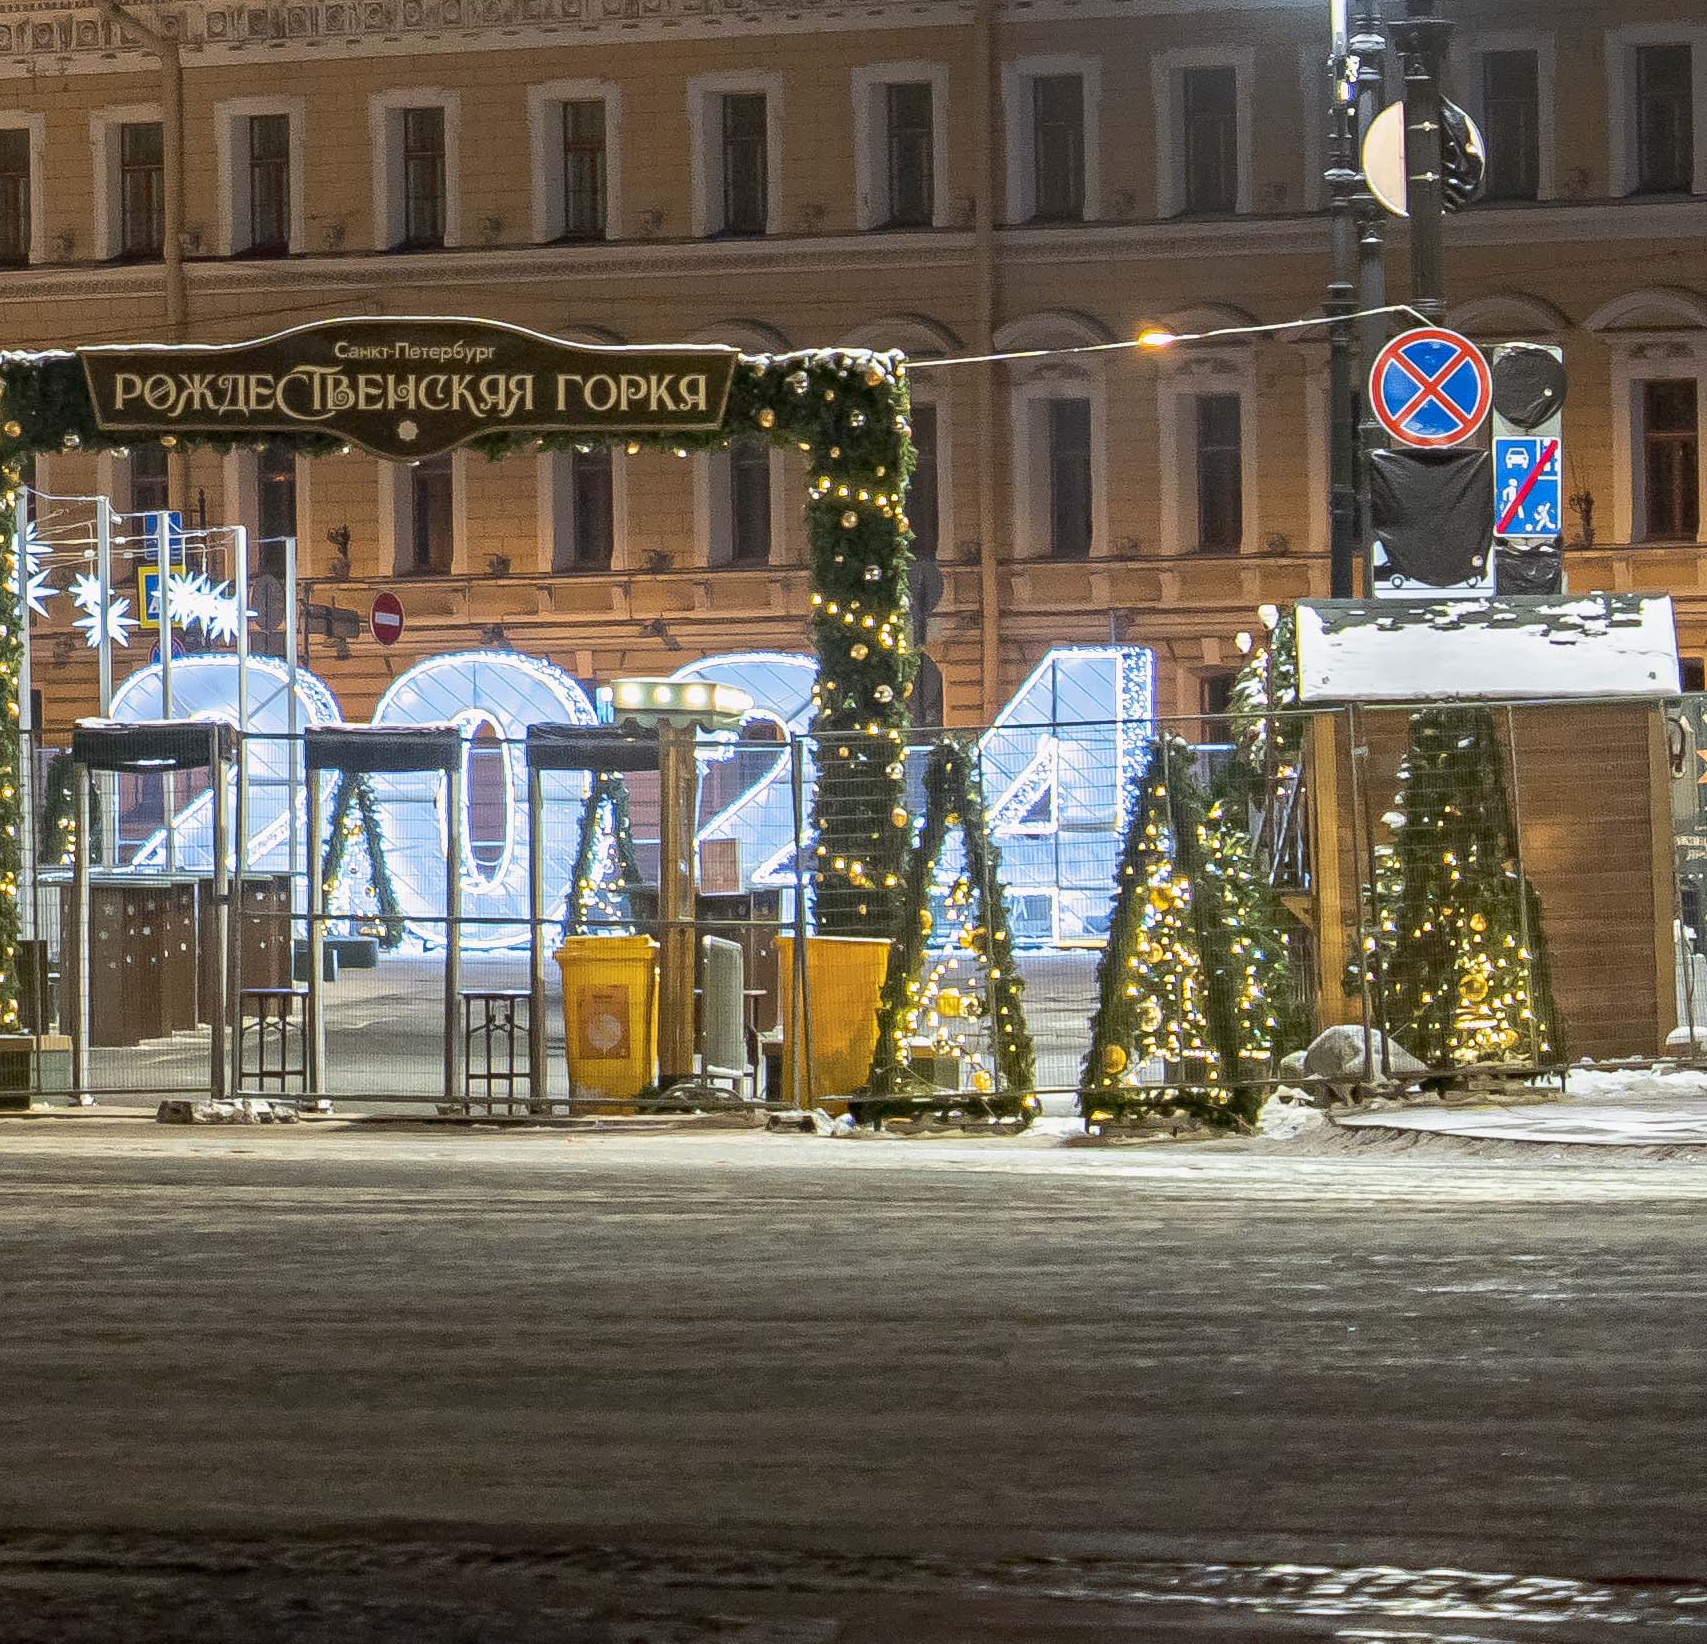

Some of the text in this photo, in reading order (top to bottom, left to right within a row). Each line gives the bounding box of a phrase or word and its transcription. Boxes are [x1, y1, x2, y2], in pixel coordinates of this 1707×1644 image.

[334, 340, 495, 363] Санкт-Петербург
[114, 365, 707, 420] РОЖДЕСТВЕНСКАЯ ГОРКА
